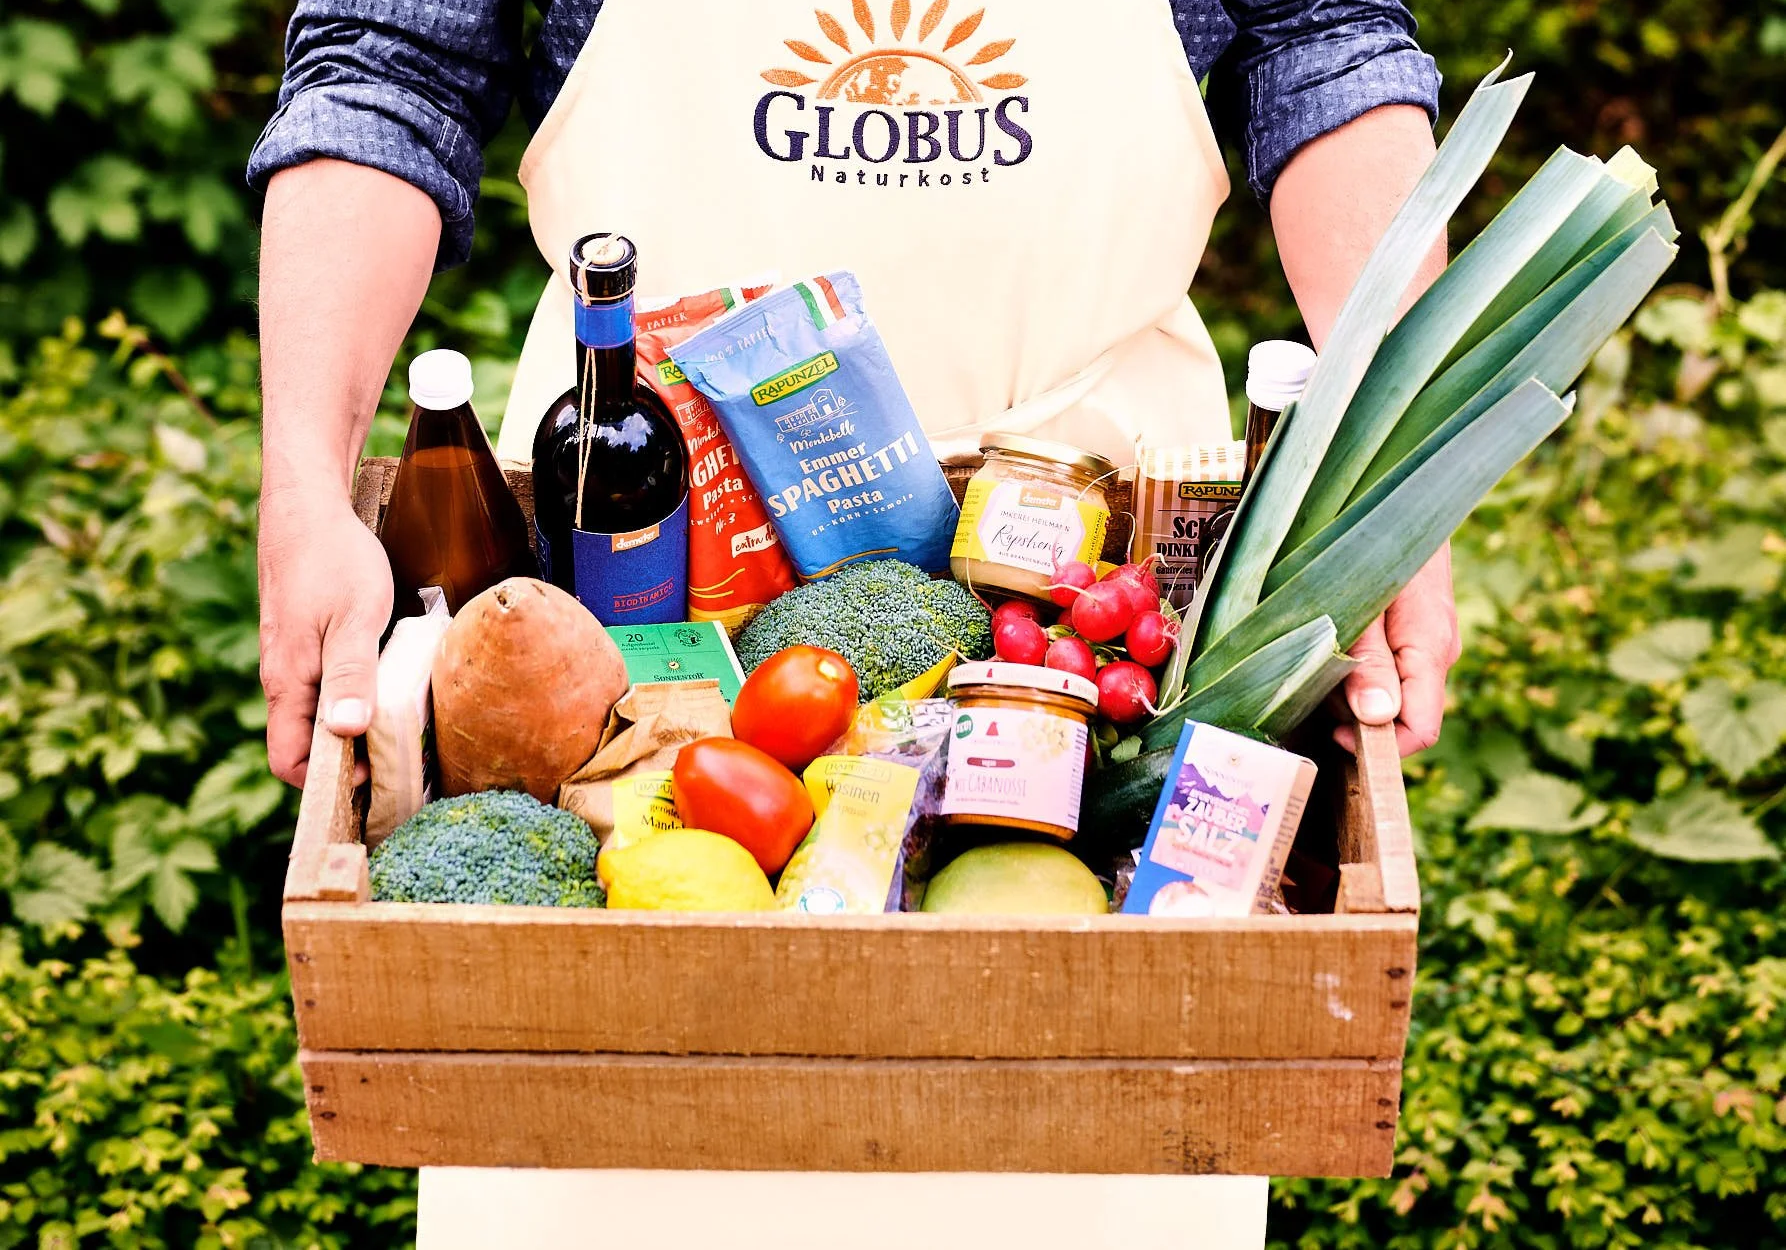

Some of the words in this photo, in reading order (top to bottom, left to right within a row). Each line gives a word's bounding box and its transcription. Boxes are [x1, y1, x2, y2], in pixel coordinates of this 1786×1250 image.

[753, 90, 1034, 167] GLOBUS
[811, 164, 990, 188] Naturkost
[755, 357, 835, 401] RAPUNZEL
[789, 419, 856, 455] Montebello
[767, 431, 920, 518] SPAGHETTI
[799, 441, 867, 475] Emmer
[702, 477, 744, 511] Pasta
[827, 488, 884, 514] Pasta
[1183, 485, 1242, 497] RAPUNZ
[811, 511, 861, 536] UR-KORN
[873, 493, 914, 514] Semola
[616, 530, 656, 549] demeter
[735, 535, 764, 552] extra
[613, 582, 675, 609] BIODINAMICO
[625, 633, 644, 643] 20
[1185, 796, 1248, 834] ZAUBER
[1175, 815, 1243, 862] SALZ
